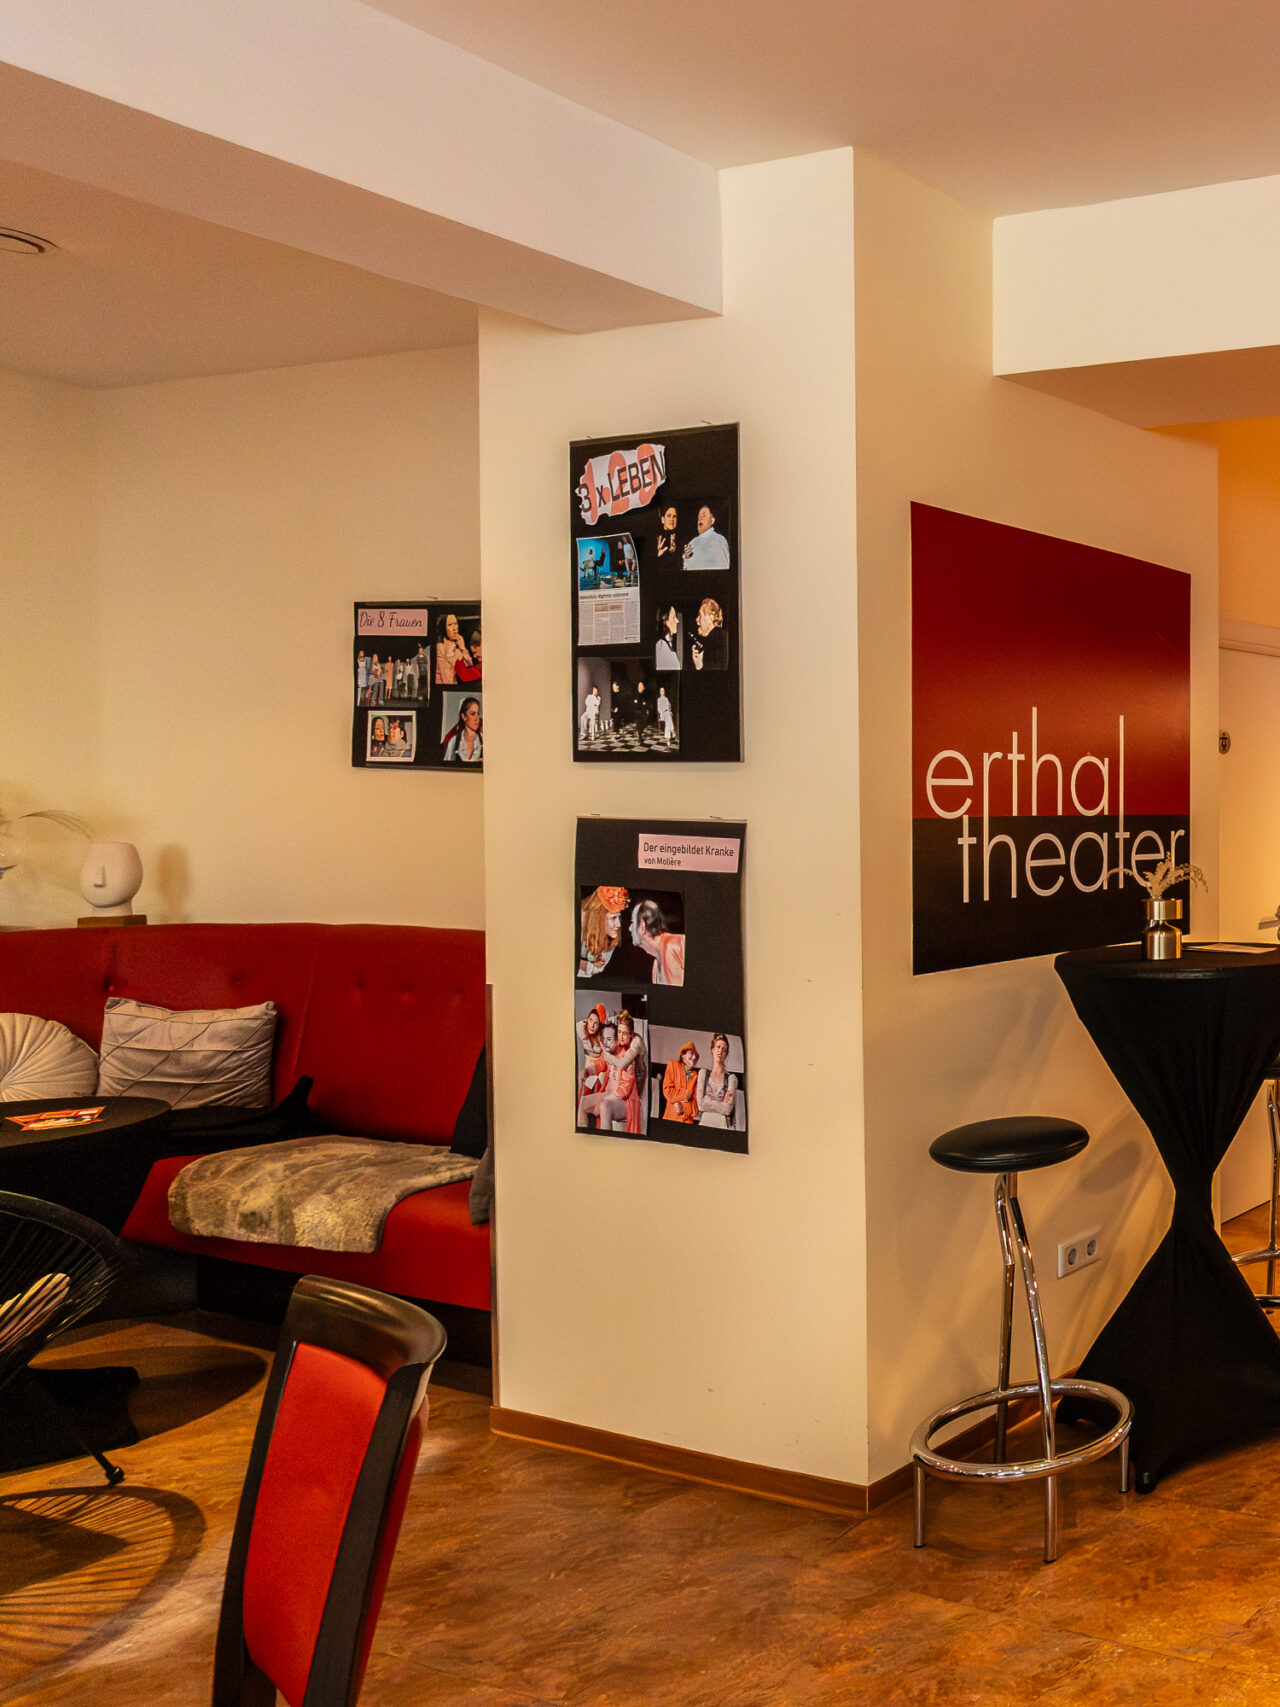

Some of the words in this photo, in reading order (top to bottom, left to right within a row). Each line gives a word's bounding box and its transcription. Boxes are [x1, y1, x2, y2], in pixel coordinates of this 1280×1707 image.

[578, 483, 592, 512] 3
[607, 451, 665, 502] LEBEN
[360, 611, 375, 627] Die
[377, 611, 385, 628] 8
[389, 612, 422, 628] Frauen
[926, 706, 1124, 819] erthal
[643, 842, 658, 852] Der
[660, 843, 704, 855] eingebildet
[705, 845, 734, 856] Kranke
[657, 857, 682, 866] Molière
[957, 814, 1185, 903] theater
